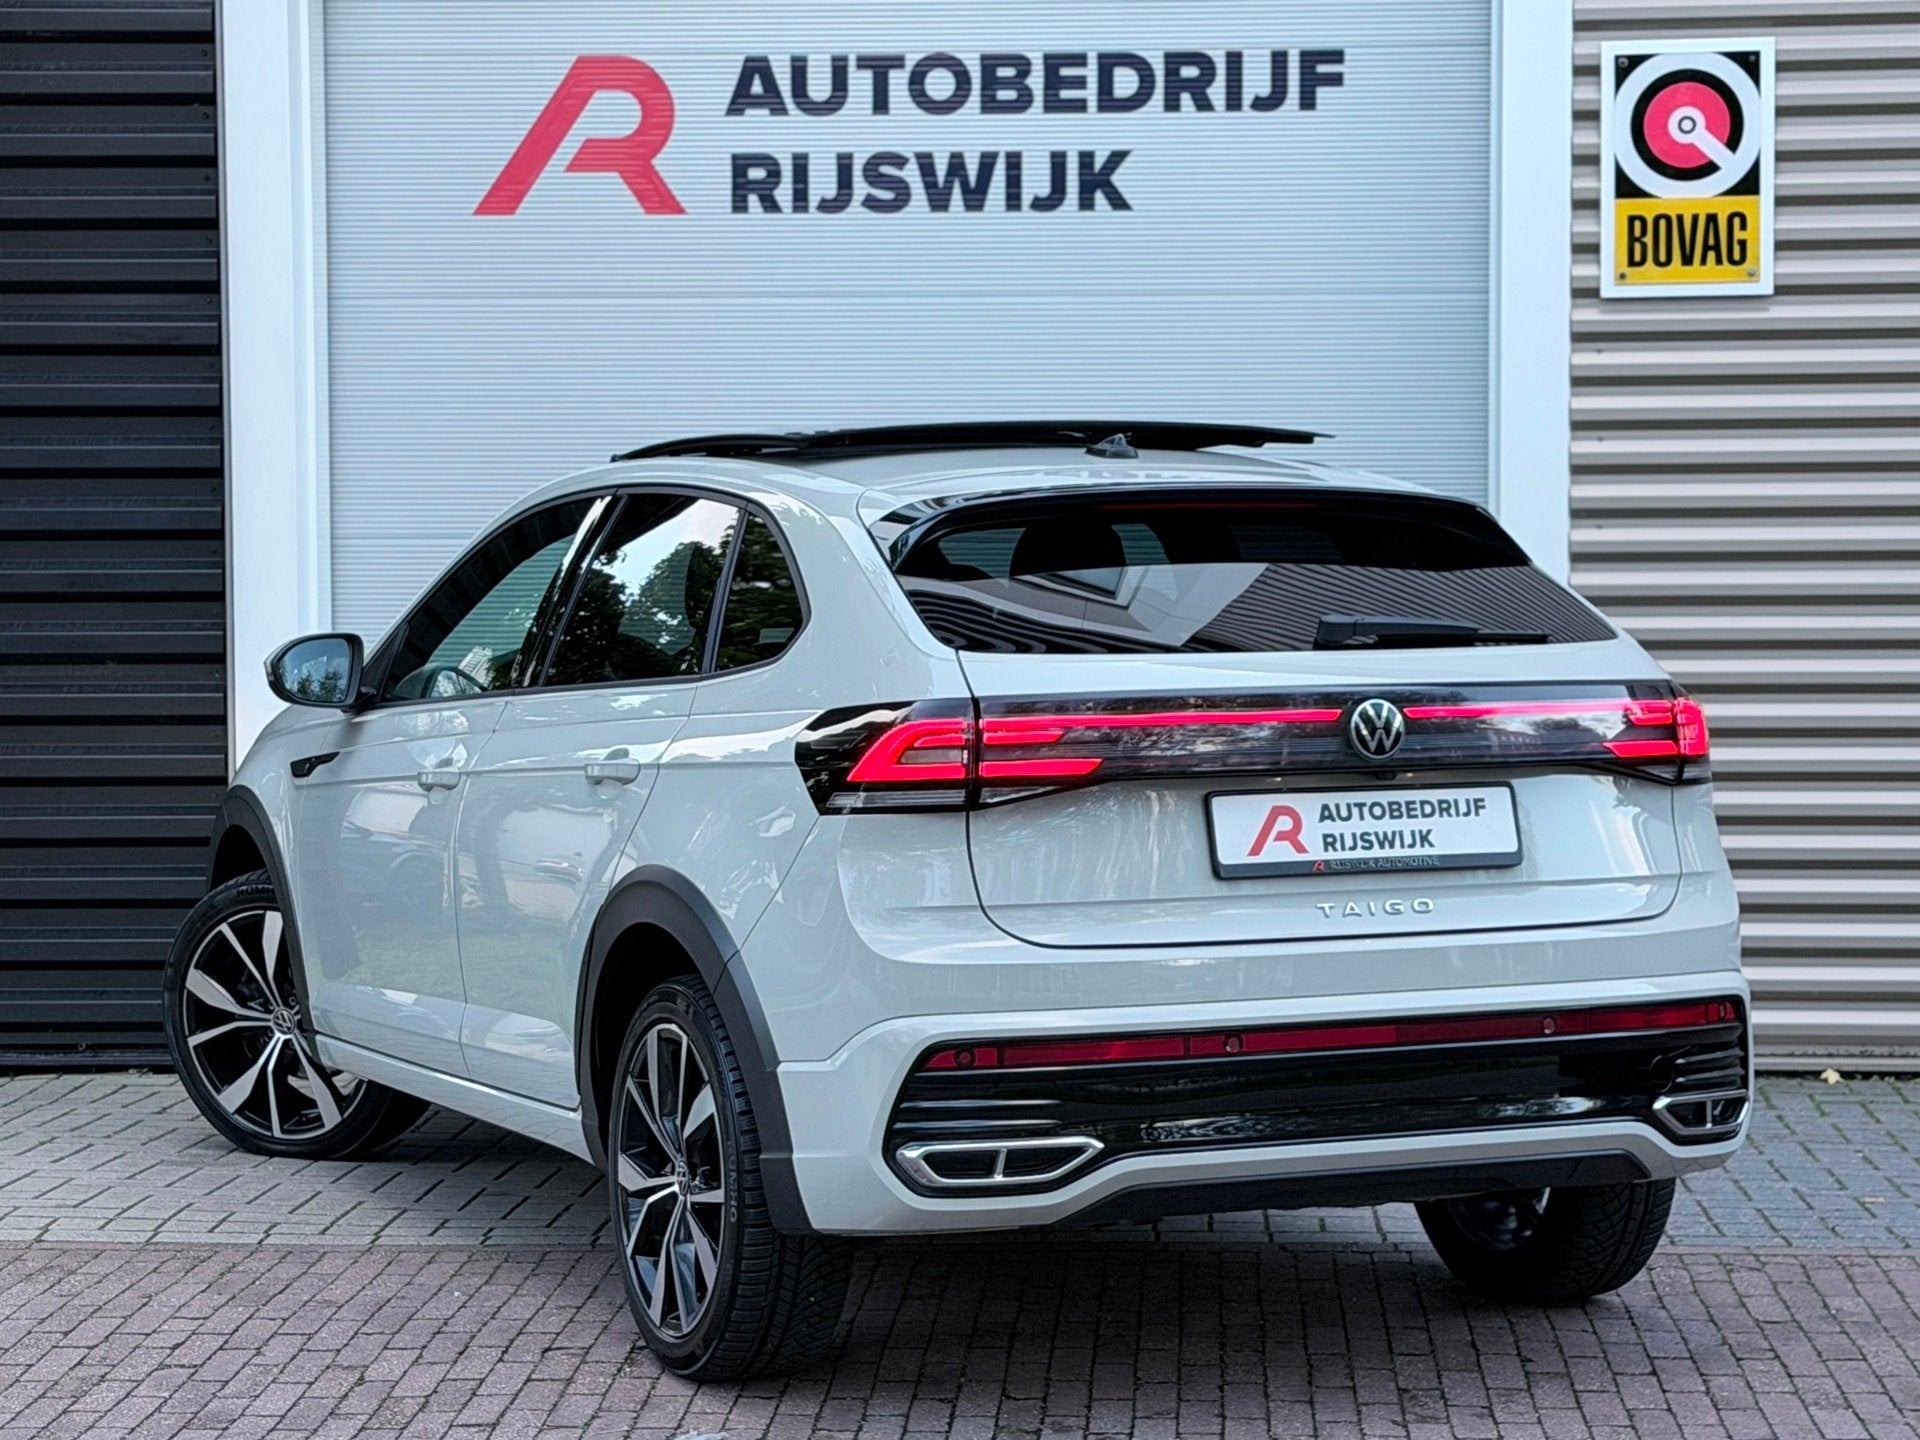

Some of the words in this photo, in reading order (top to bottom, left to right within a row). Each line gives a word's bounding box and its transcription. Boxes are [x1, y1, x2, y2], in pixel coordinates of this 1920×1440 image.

[725, 48, 1345, 117] AUTOBEDRIJF
[731, 150, 1133, 215] RIJSWIJK
[1626, 210, 1748, 268] BOVAG
[1318, 797, 1487, 824] AUTOBEDRIJF
[1322, 828, 1437, 854] RIJSWIJK
[1377, 855, 1441, 869] AUTOMOTIVE
[1316, 897, 1436, 919] TAIGO
